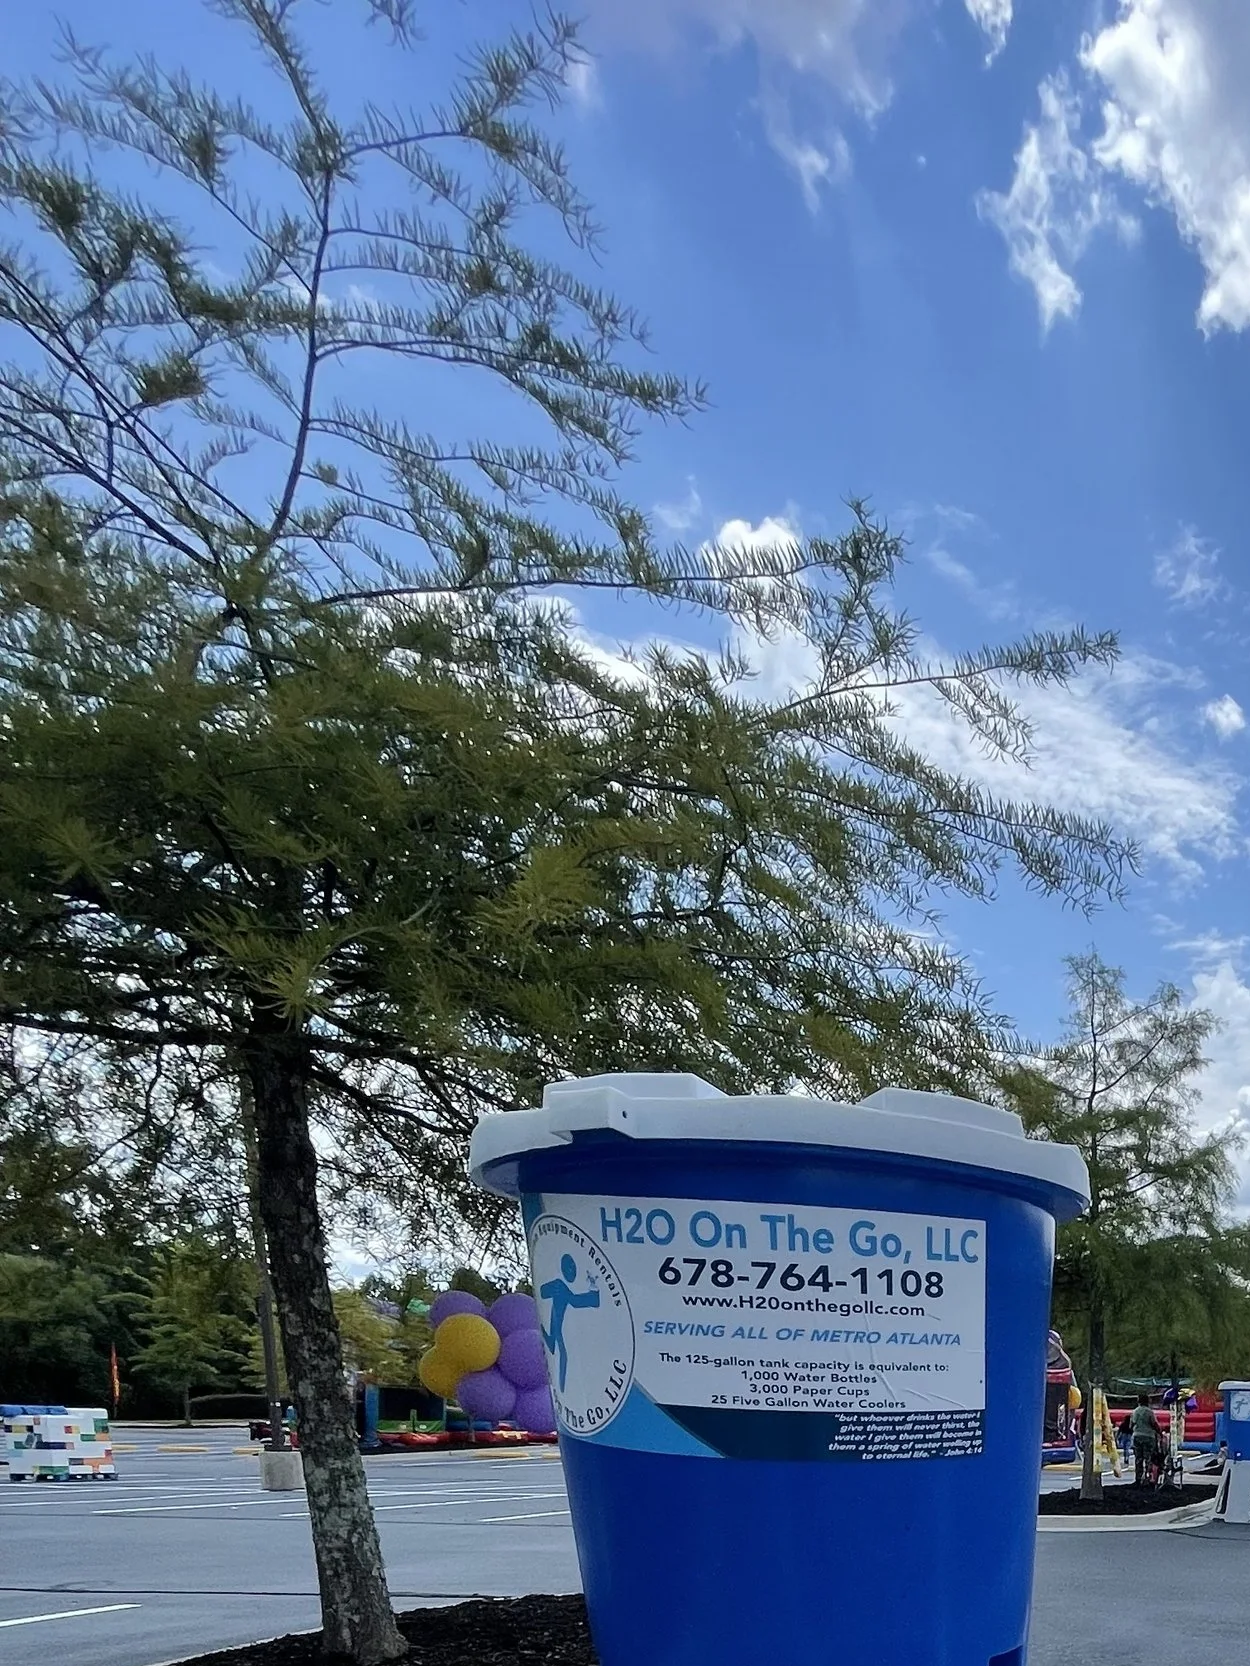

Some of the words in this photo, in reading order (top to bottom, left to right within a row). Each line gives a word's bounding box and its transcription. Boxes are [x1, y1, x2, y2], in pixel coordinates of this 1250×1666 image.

[689, 1210, 748, 1248] On
[759, 1213, 835, 1254] The
[848, 1220, 912, 1264] Go,
[926, 1226, 979, 1264] LLC
[587, 1245, 623, 1307] Rentals
[658, 1256, 944, 1299] 678-764-1108
[643, 1320, 726, 1338] SERVING
[731, 1326, 769, 1340] ALL
[775, 1328, 806, 1341] OF
[810, 1329, 882, 1344] METRO
[886, 1332, 962, 1346] ATLANTA
[659, 1352, 681, 1363] The
[685, 1354, 755, 1368] 125-gallon
[759, 1358, 790, 1369] tank
[794, 1360, 850, 1373] capacity
[854, 1361, 865, 1371] is
[868, 1362, 931, 1373] equivalent
[934, 1363, 949, 1372] to:
[741, 1370, 779, 1381] 1,000
[784, 1372, 826, 1382] Water
[831, 1373, 877, 1383] Bottles
[564, 1406, 585, 1429] The
[604, 1359, 627, 1404] LLC
[749, 1383, 788, 1395] 3,000
[793, 1385, 833, 1397] Paper
[837, 1386, 870, 1398] Cups
[711, 1394, 728, 1405] 25
[732, 1395, 760, 1406] Five
[765, 1397, 809, 1408] Gallon
[813, 1399, 854, 1409] Water
[858, 1399, 906, 1409] Coolers
[860, 1413, 906, 1422] whoever
[906, 1413, 936, 1422] drinks
[937, 1412, 952, 1420] the
[953, 1412, 976, 1420] water
[840, 1423, 864, 1433] give
[866, 1423, 894, 1432] them
[895, 1422, 913, 1431] will
[913, 1423, 940, 1431] never
[967, 1420, 981, 1428] the
[834, 1433, 867, 1441] water
[867, 1433, 874, 1441] I
[873, 1433, 897, 1443] give
[899, 1433, 924, 1441] them
[925, 1431, 942, 1440] will
[942, 1430, 975, 1439] become
[975, 1429, 982, 1437] in
[828, 1442, 857, 1451] them
[867, 1442, 900, 1452] spring
[901, 1441, 914, 1450] of
[914, 1441, 942, 1449] water
[972, 1439, 983, 1447] up
[862, 1452, 874, 1460] to
[876, 1451, 912, 1459] eternal
[944, 1448, 966, 1457] John
